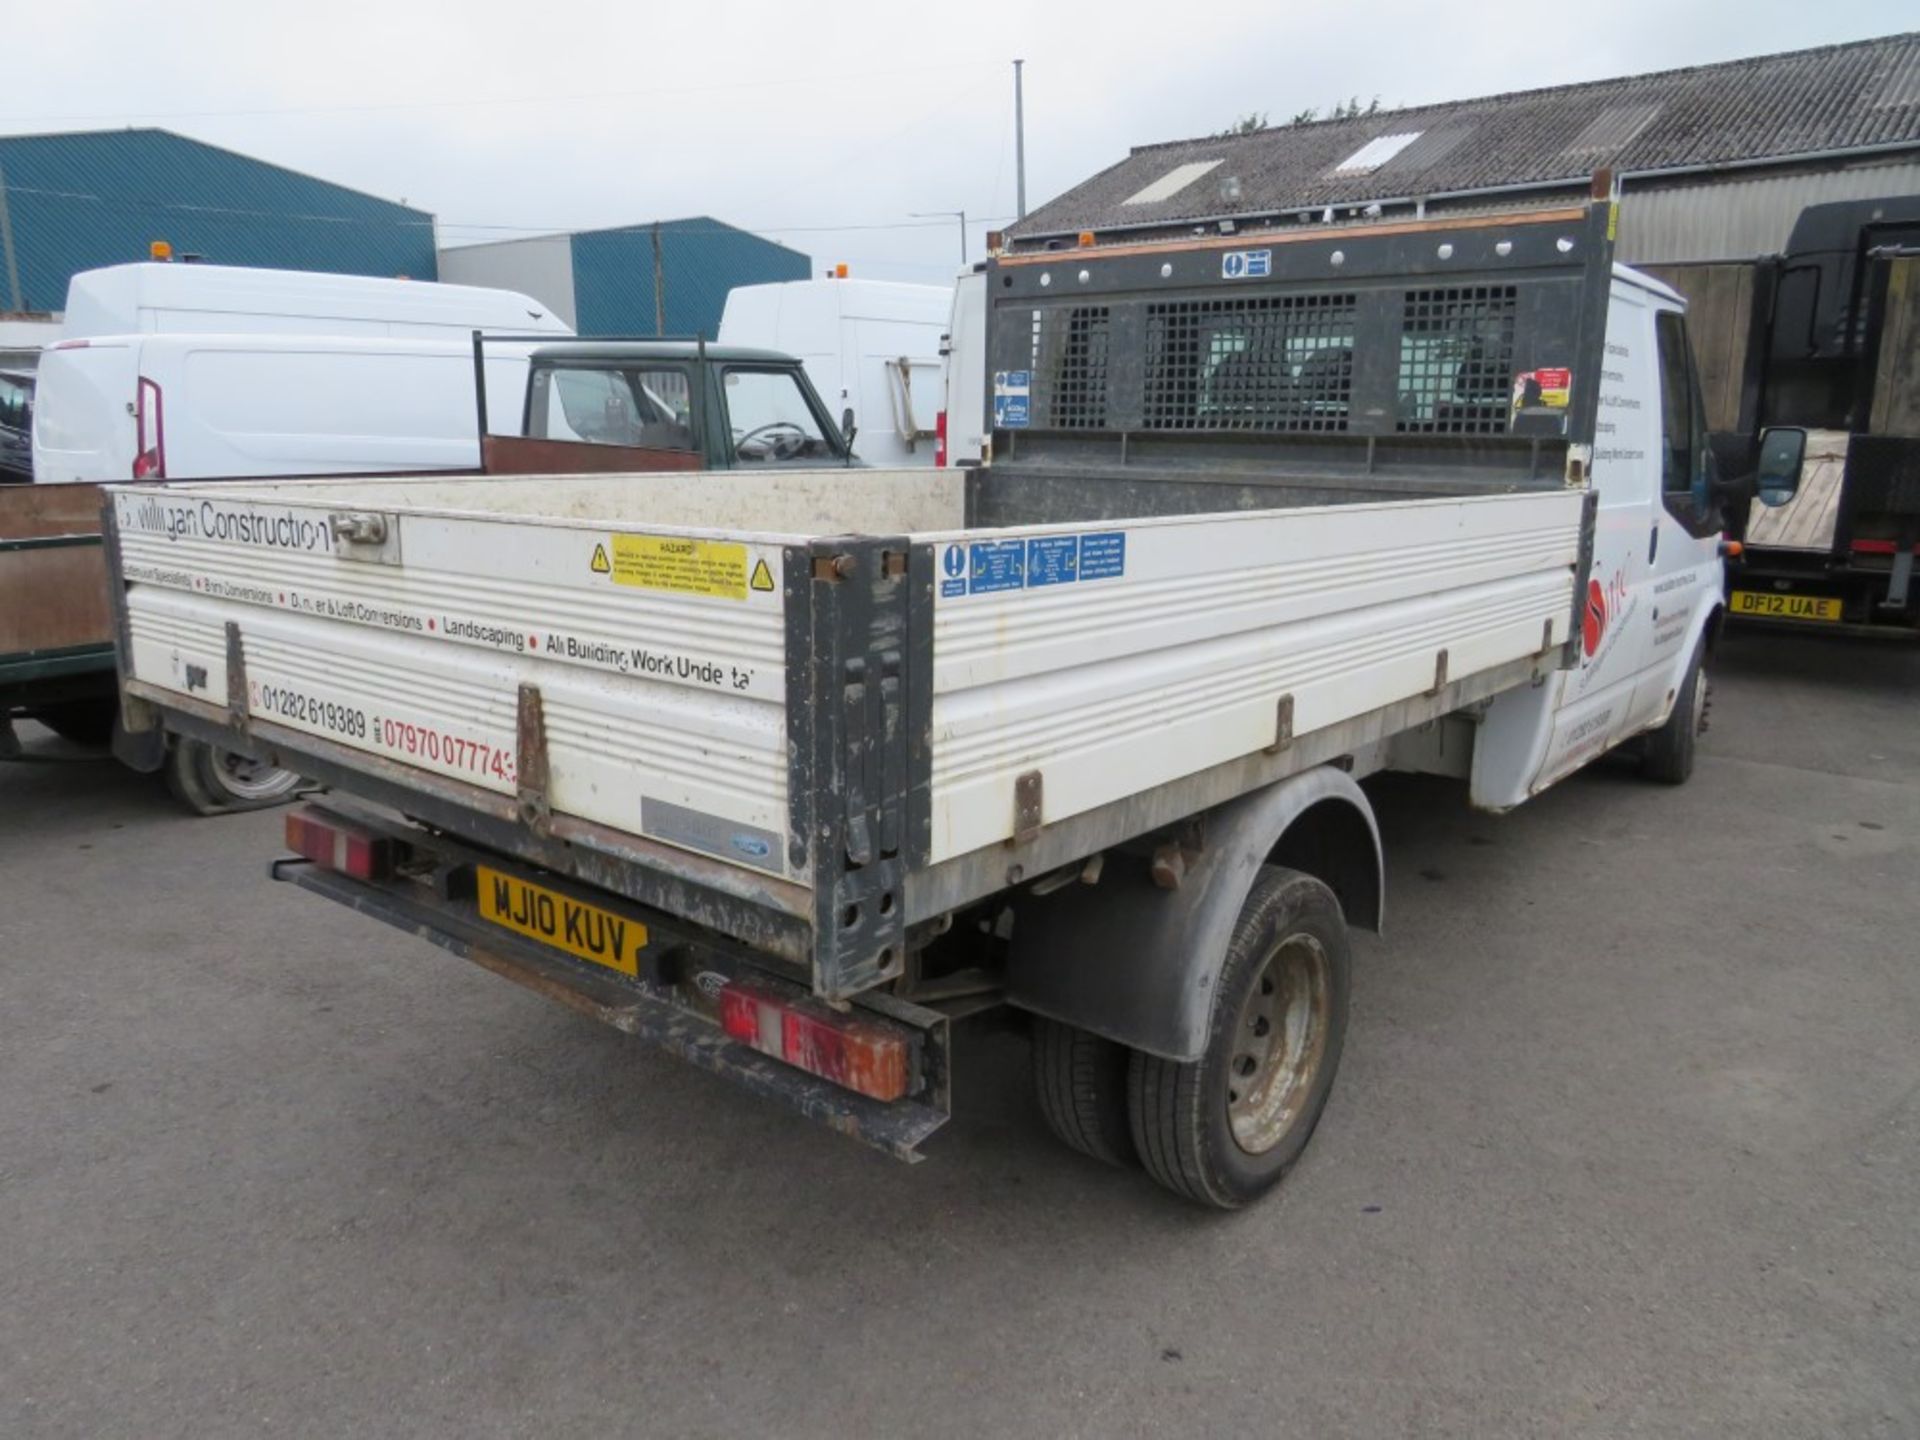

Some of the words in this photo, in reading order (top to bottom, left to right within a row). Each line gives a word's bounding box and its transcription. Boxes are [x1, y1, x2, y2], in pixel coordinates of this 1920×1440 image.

[200, 500, 330, 552] Construction
[1742, 594, 1785, 613] DF12
[1790, 598, 1829, 616] UAE
[442, 616, 525, 652] Landscaping
[567, 637, 629, 672] Building
[631, 649, 675, 676] Work
[262, 684, 306, 721] 01282
[308, 697, 366, 739] 619389
[384, 718, 440, 760] 07970
[493, 876, 556, 937] MJ10
[564, 901, 625, 962] KUV
